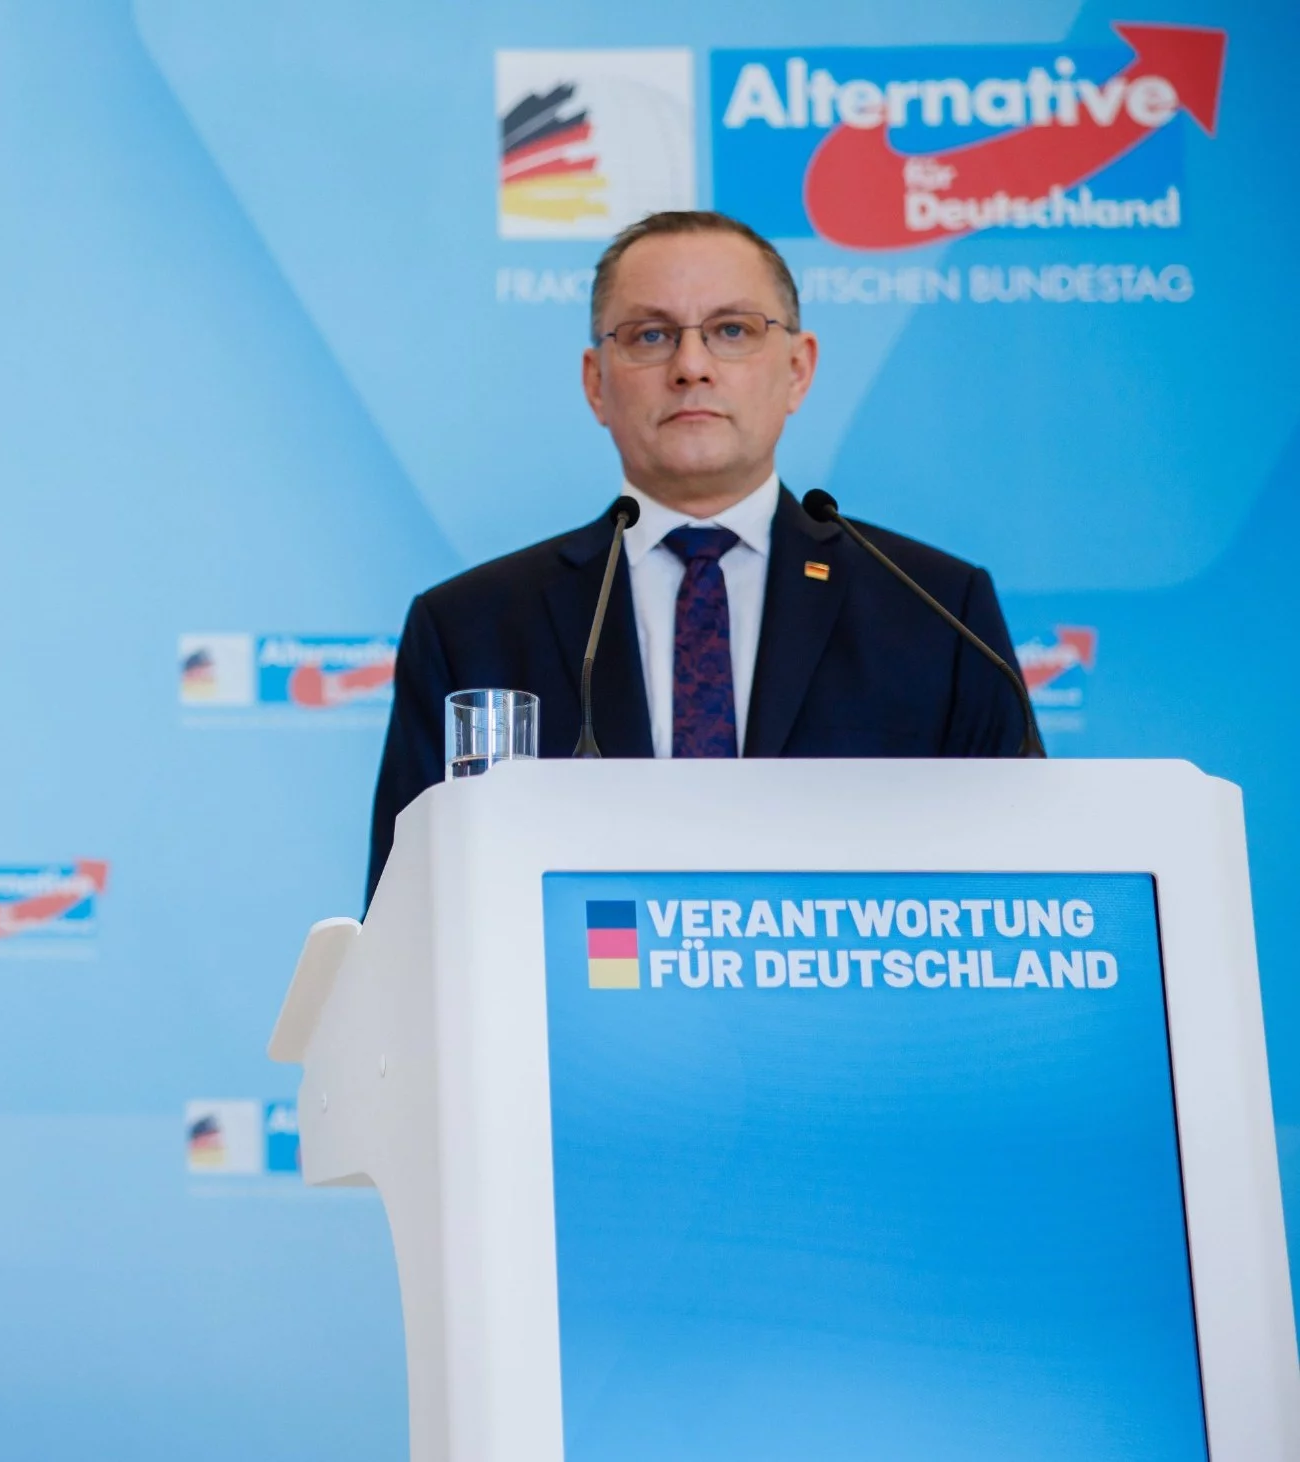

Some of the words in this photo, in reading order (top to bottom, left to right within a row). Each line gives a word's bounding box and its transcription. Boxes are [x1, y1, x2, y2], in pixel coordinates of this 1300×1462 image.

[722, 56, 1180, 130] Alternative
[904, 184, 1182, 231] Deutschland
[495, 267, 595, 304] FRAK
[791, 265, 962, 304] UTSCHEN
[969, 263, 1194, 304] BUNDESTAG
[646, 899, 1095, 939] VERANTWORTUNG
[649, 938, 744, 990] FÜR
[754, 949, 1118, 990] DEUTSCHLAND
